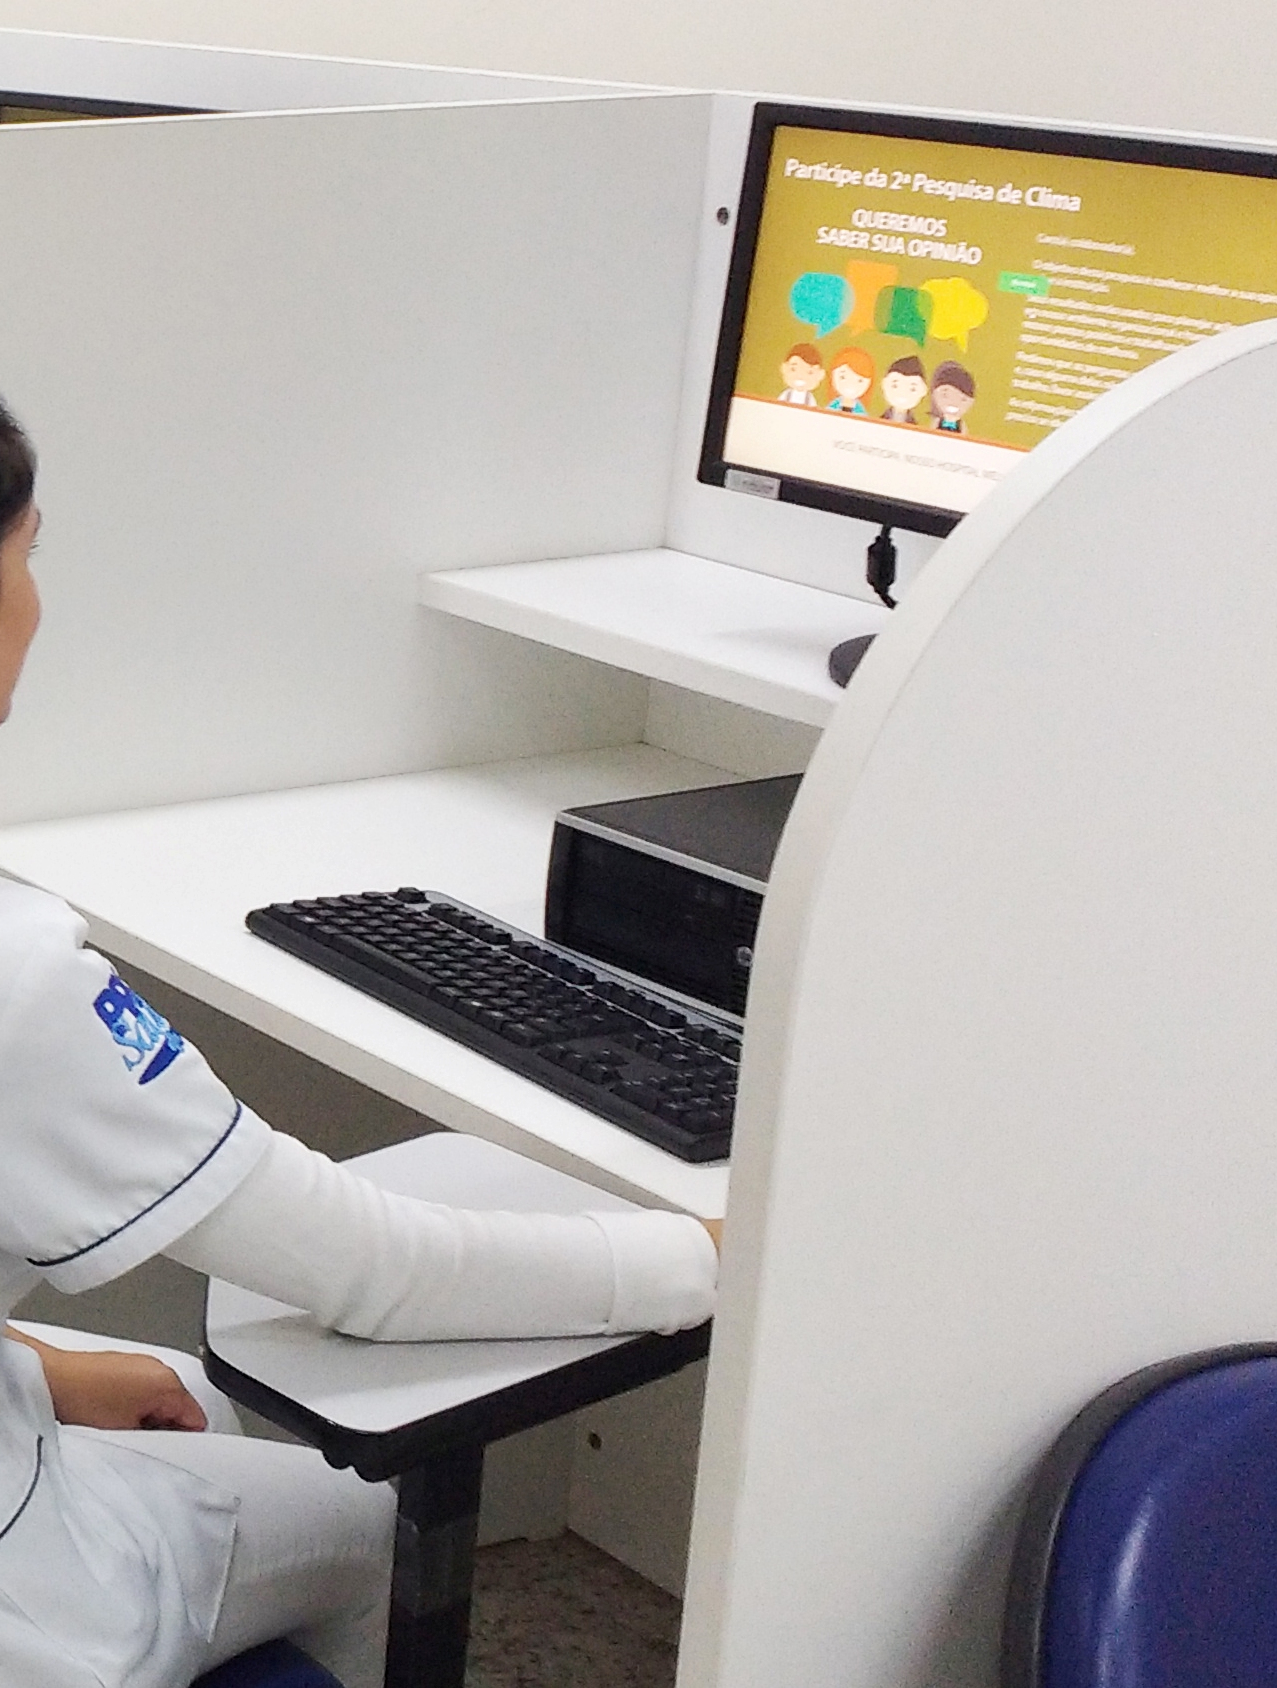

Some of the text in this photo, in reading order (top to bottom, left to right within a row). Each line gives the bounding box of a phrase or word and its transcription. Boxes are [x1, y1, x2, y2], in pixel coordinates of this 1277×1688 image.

[784, 158, 862, 188] Participe
[863, 167, 888, 188] da
[911, 173, 994, 201] Pesquisa
[996, 182, 1022, 205] de
[1025, 186, 1081, 211] Clima
[851, 209, 947, 237] QUEREMOS
[816, 226, 982, 265] SABER SUA OPINIÃO
